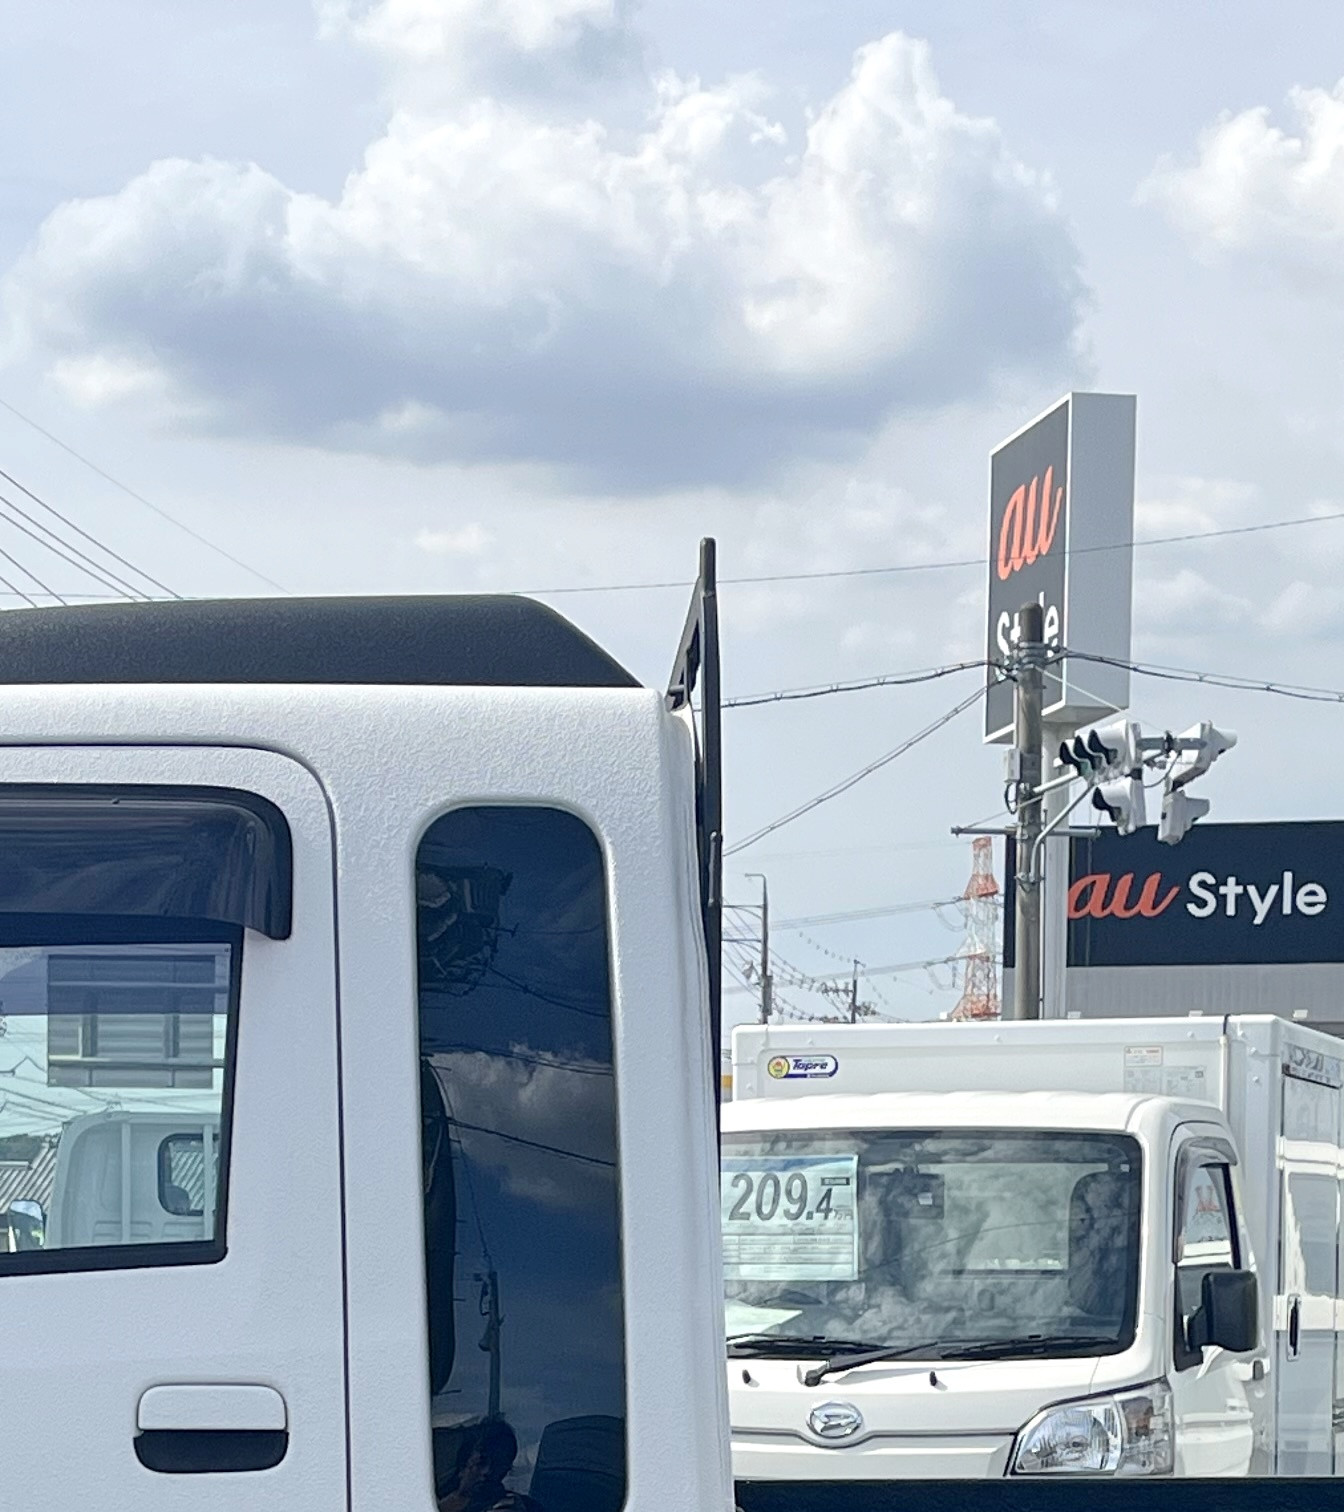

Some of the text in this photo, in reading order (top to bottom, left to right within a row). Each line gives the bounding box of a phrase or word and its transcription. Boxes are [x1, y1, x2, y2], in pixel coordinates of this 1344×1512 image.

[997, 465, 1063, 580] au
[1068, 871, 1180, 919] au
[1186, 871, 1327, 925] Style
